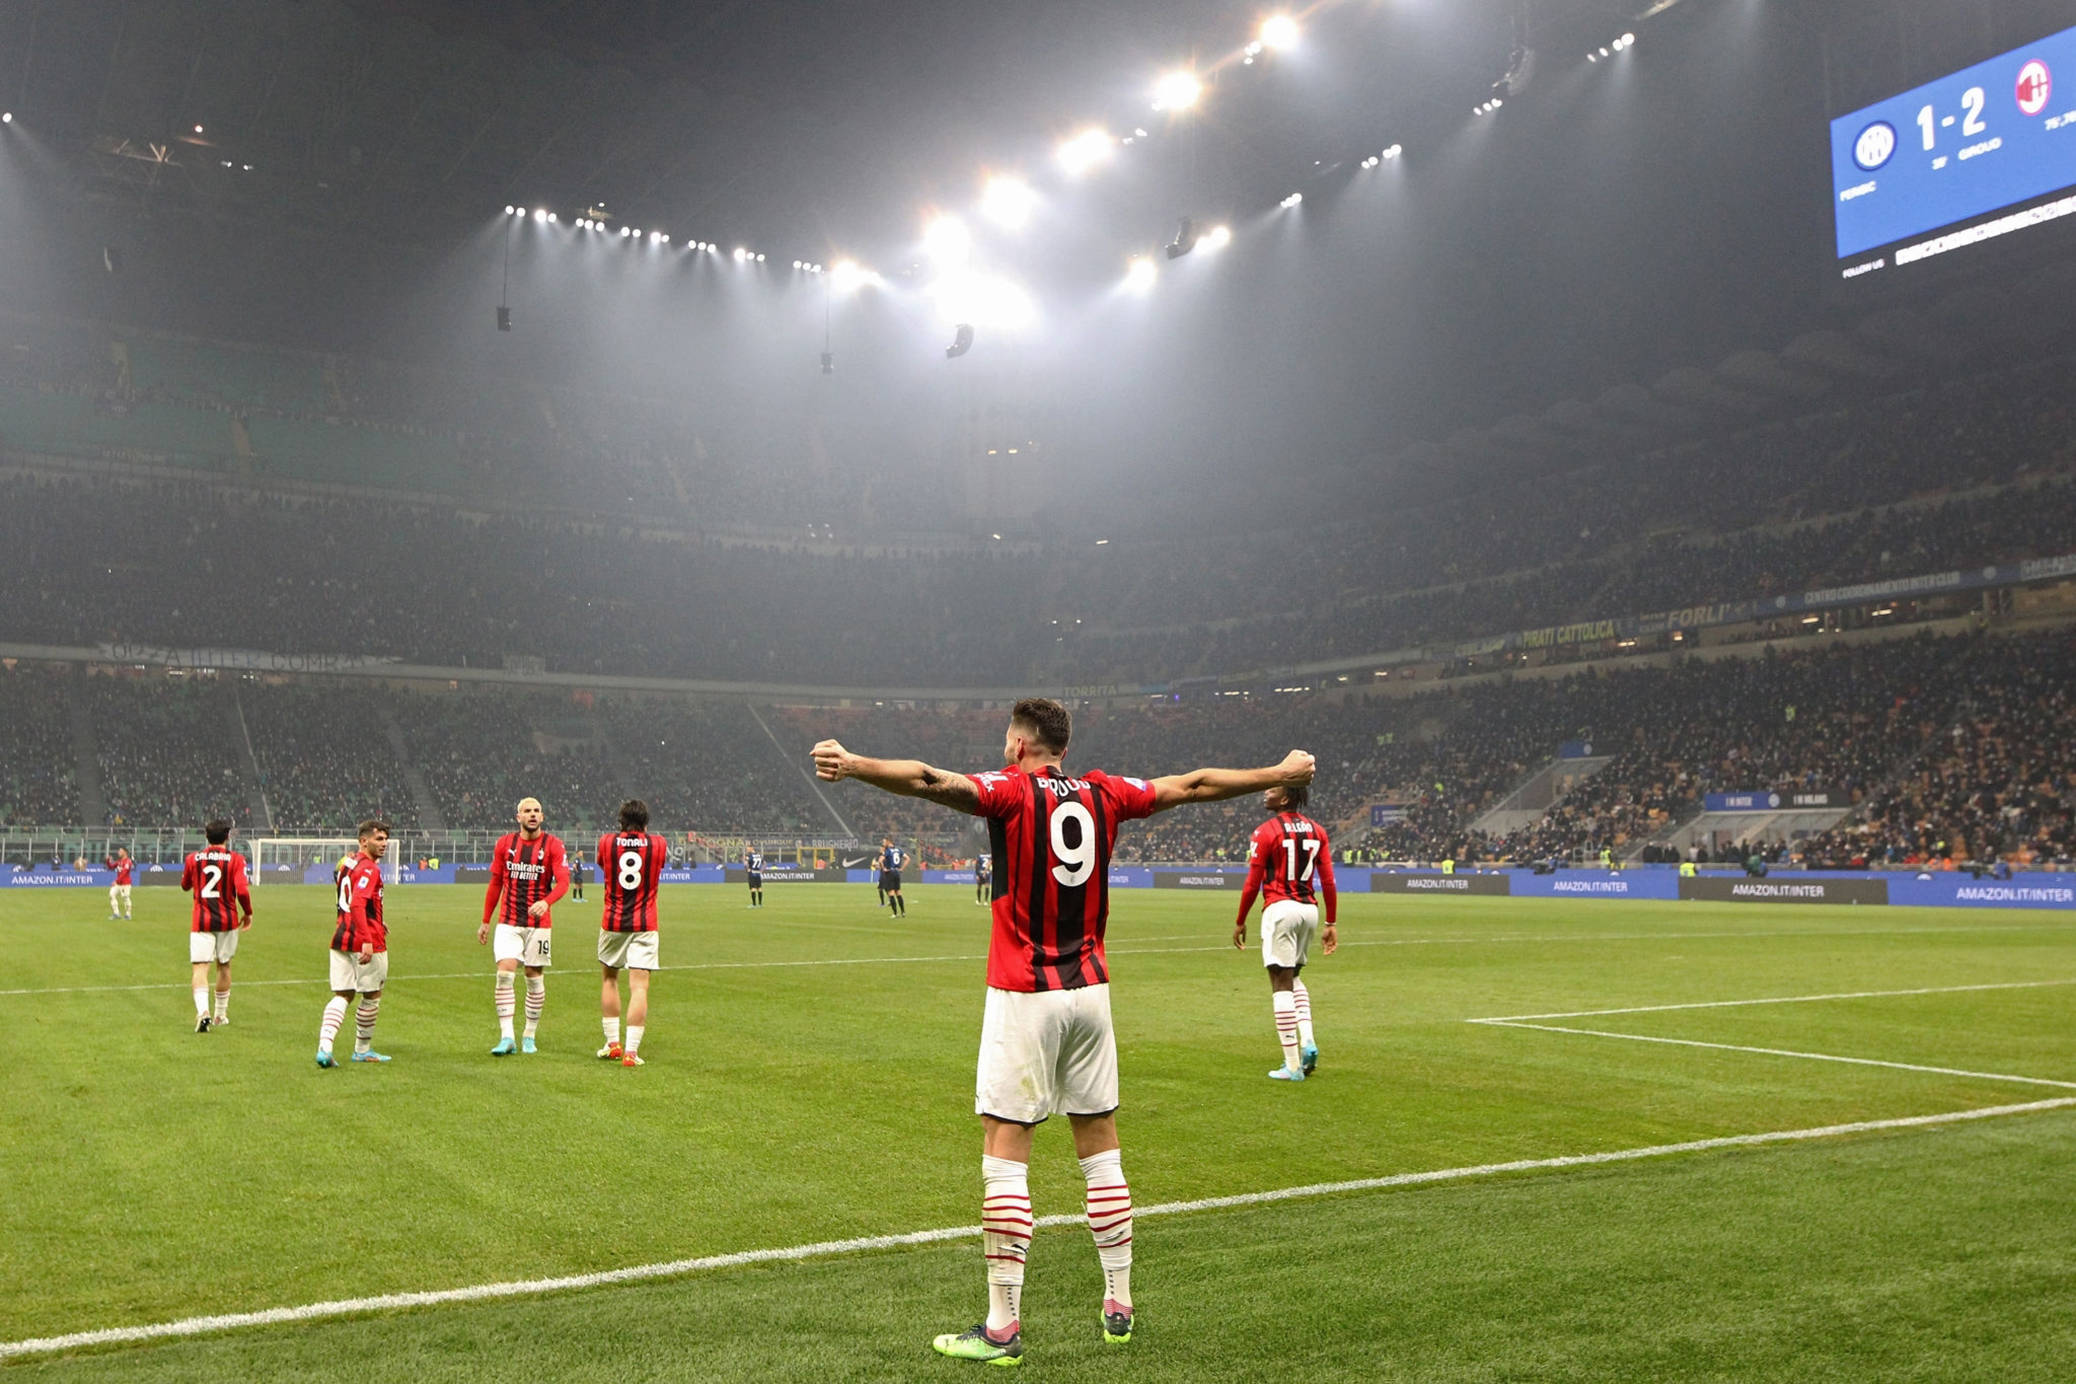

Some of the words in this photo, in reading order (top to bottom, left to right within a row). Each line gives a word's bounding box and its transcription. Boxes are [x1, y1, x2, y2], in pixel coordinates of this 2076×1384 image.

[1842, 263, 1873, 279] FOLLOW
[1523, 626, 1556, 648] PIRATI
[1557, 619, 1615, 643] CATTOLICA
[616, 837, 648, 847] TONALI
[1050, 800, 1096, 888] 9
[195, 852, 231, 862] CALABRIA
[1282, 838, 1321, 881] 17
[506, 861, 545, 873] Emirates
[618, 851, 643, 890] 8
[12, 875, 93, 886] AMAZON.IT/INTER
[201, 864, 221, 898] 2
[1406, 879, 1469, 890] AMAZON.IT/INTER
[1553, 881, 1628, 893] AMAZON.IT/INTER
[1732, 884, 1825, 898] AMAZON.IT/INTER
[1956, 887, 2074, 903] AMAZON.IT/INTER
[537, 940, 549, 955] 19
